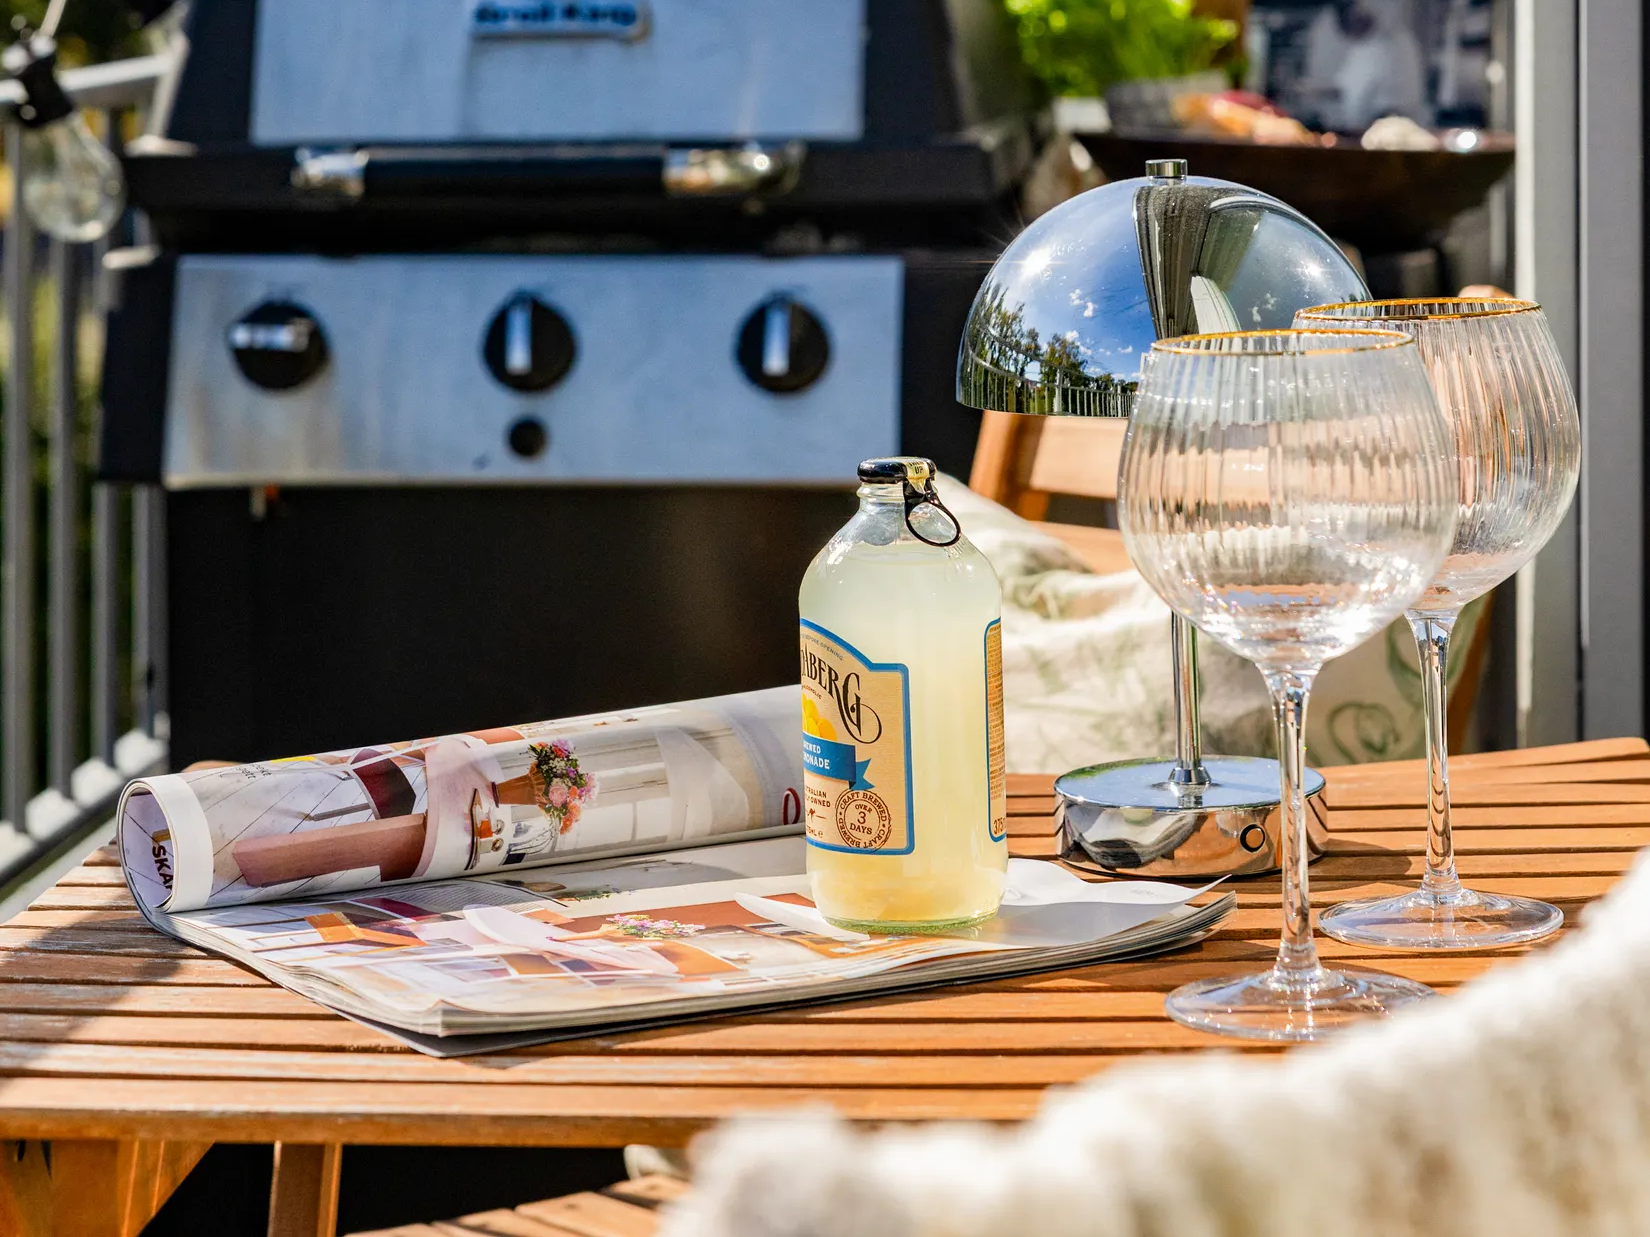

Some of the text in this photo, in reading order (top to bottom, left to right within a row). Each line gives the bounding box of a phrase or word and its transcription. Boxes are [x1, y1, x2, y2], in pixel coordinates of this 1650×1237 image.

[820, 643, 843, 661] OPENING
[800, 643, 882, 745] ABERG
[839, 792, 888, 822] CRAFT BREWED
[854, 803, 873, 814] OVER
[857, 811, 866, 824] 3
[838, 817, 886, 849] CRAFT BREWED
[849, 822, 873, 836] DAYS
